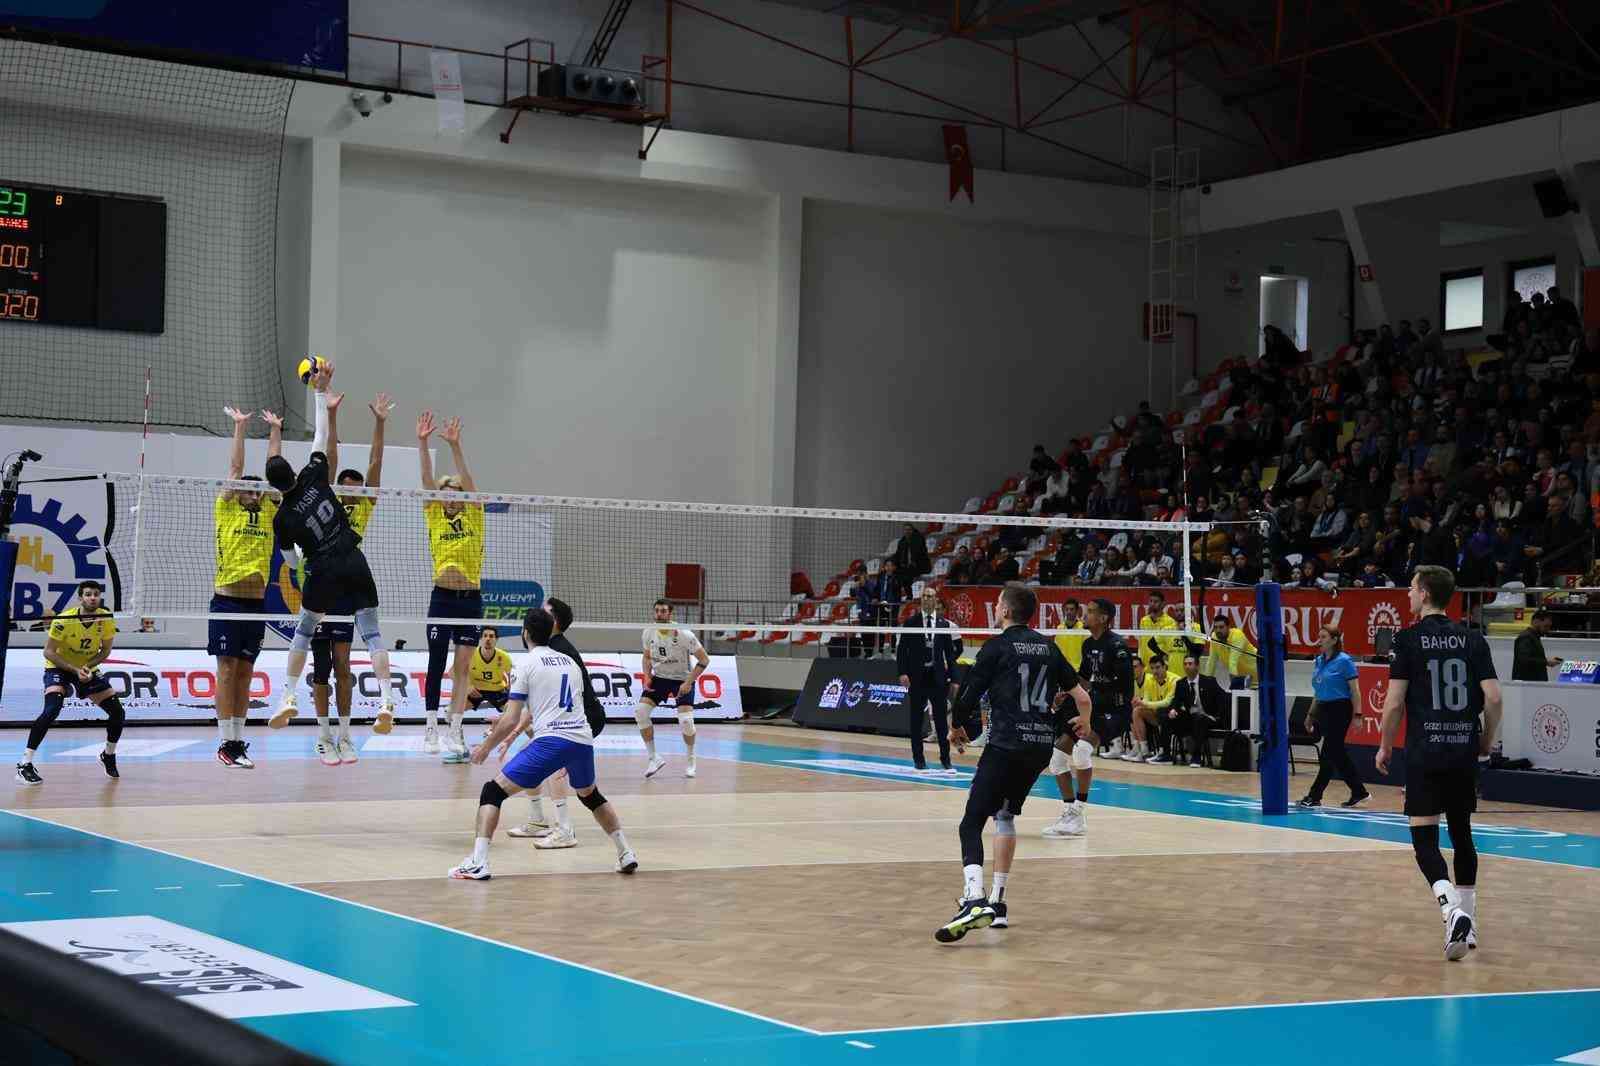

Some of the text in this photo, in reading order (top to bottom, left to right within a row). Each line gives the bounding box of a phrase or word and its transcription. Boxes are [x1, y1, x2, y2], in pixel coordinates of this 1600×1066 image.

[1421, 635, 1466, 649] BAHOV
[482, 671, 493, 680] 13
[559, 673, 574, 712] 4
[1018, 663, 1049, 712] 14
[1427, 658, 1468, 711] 18
